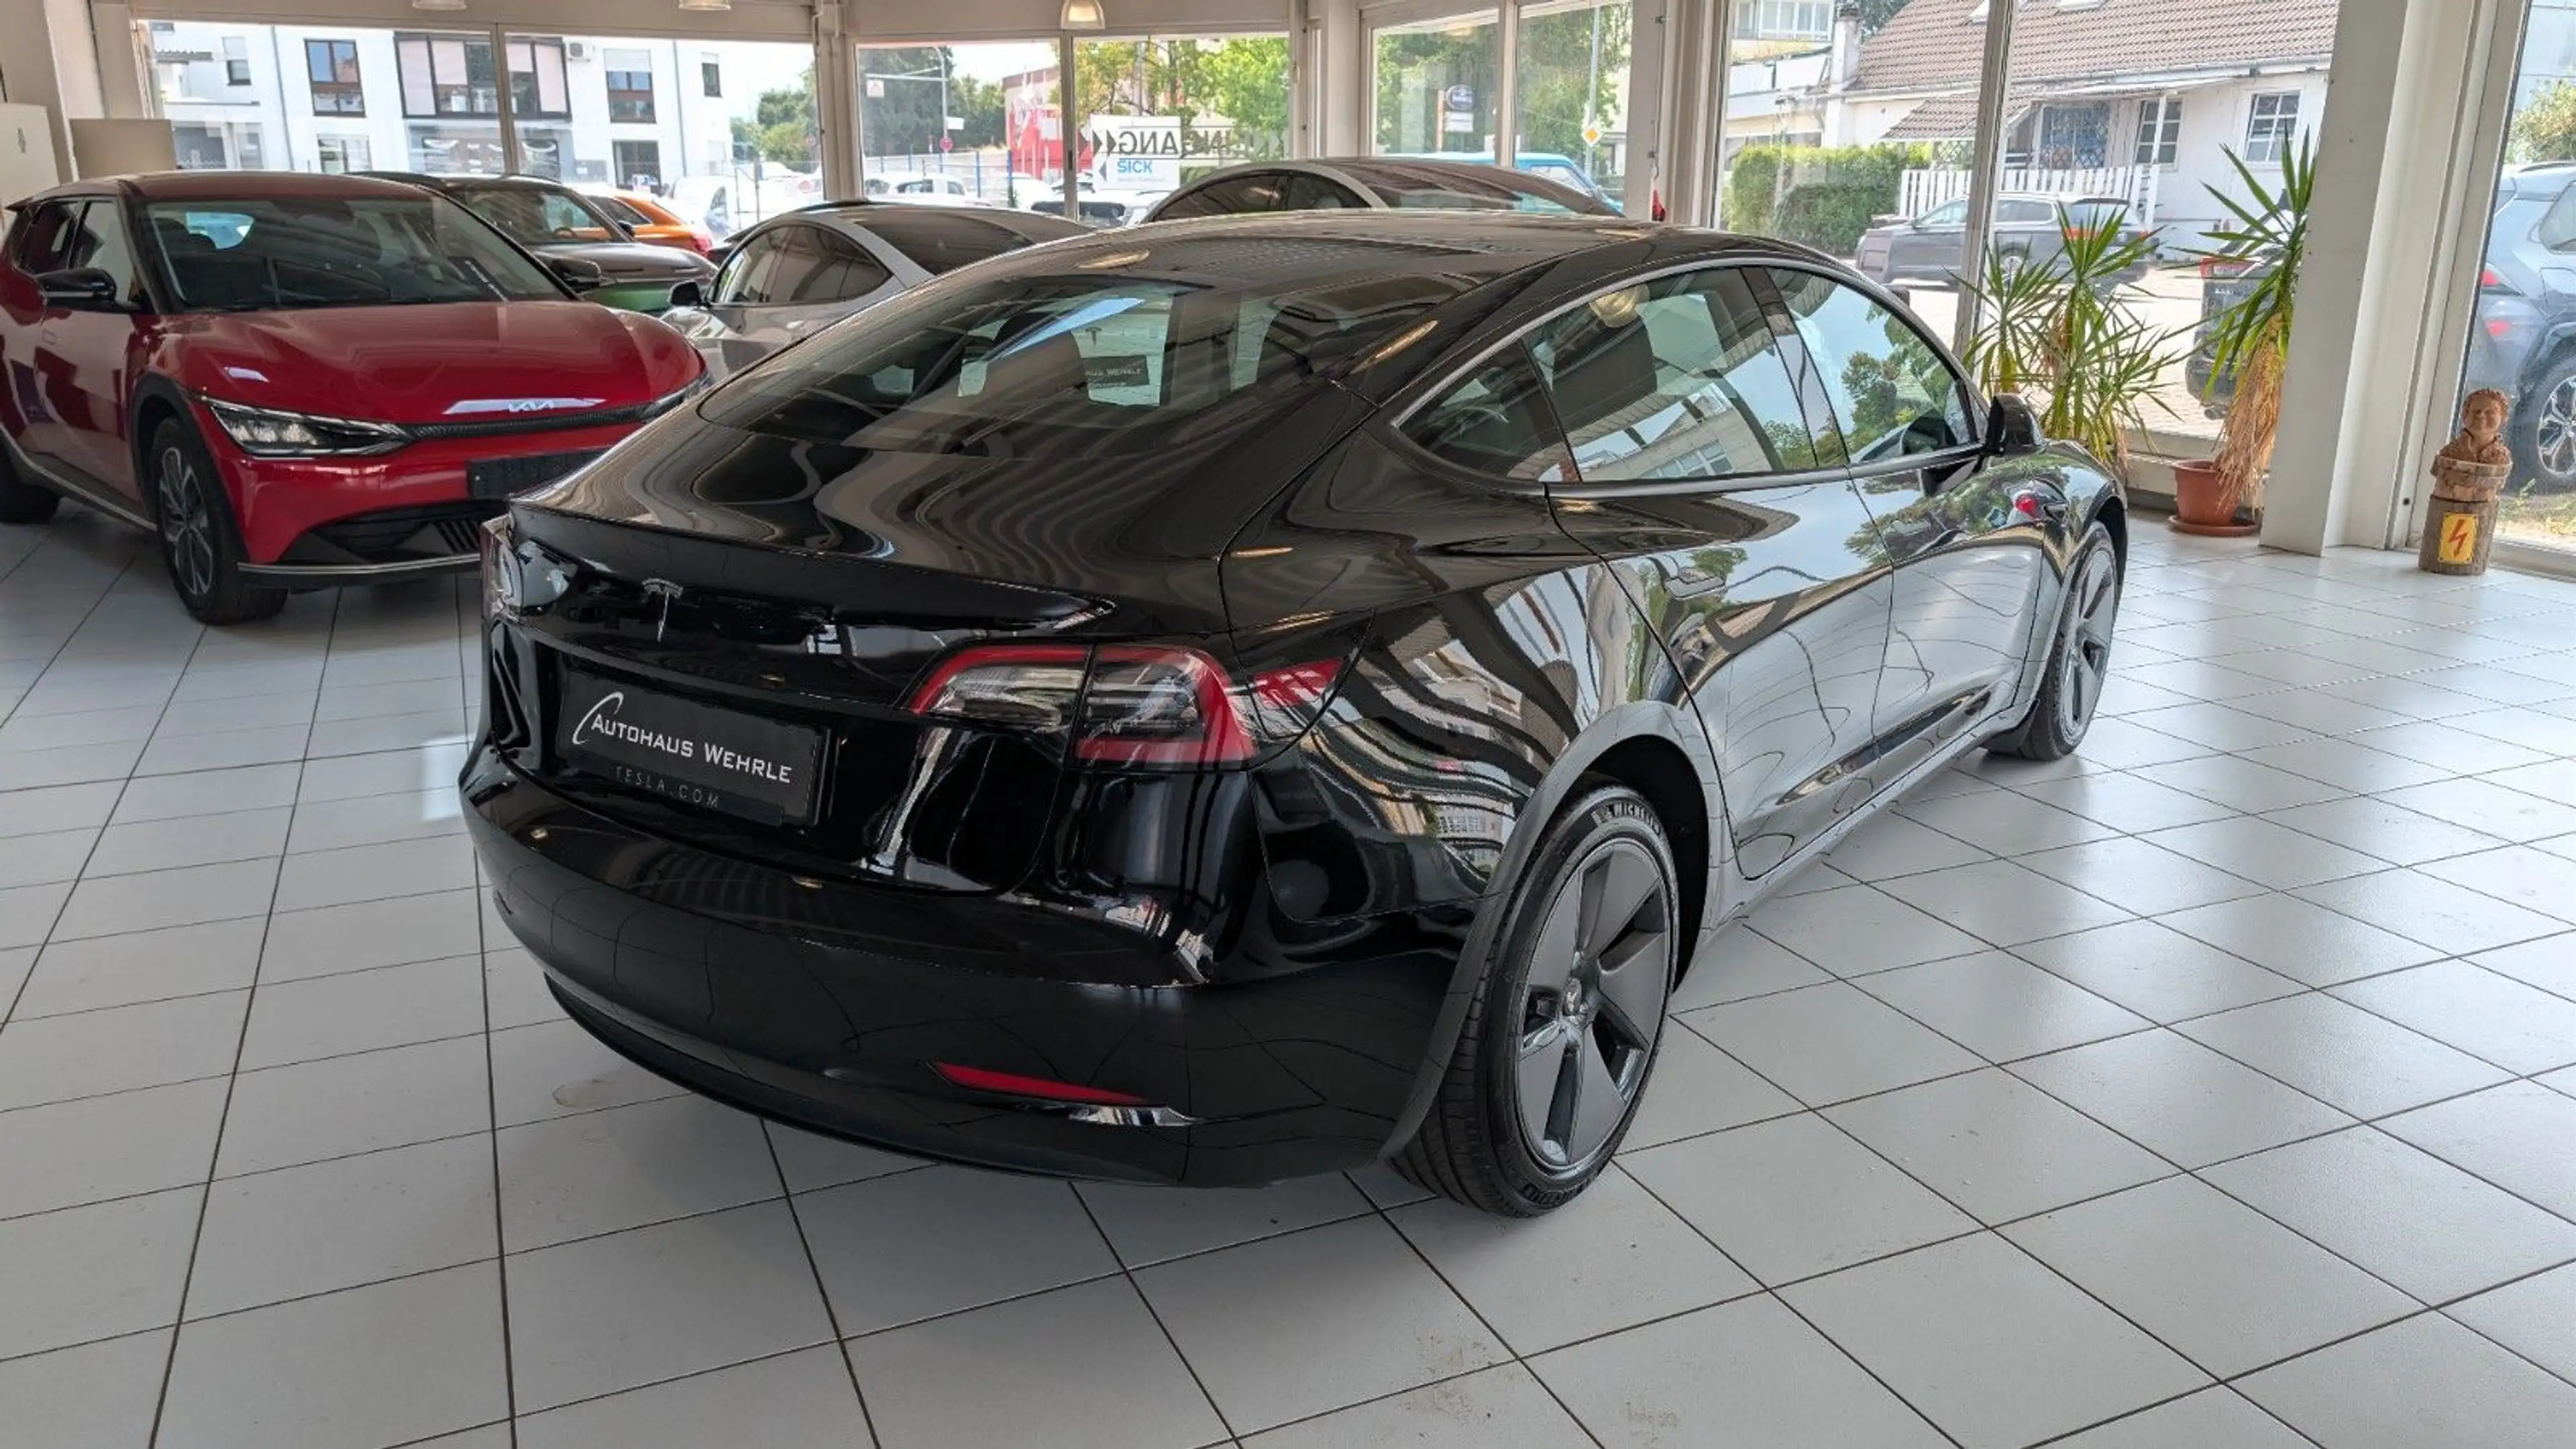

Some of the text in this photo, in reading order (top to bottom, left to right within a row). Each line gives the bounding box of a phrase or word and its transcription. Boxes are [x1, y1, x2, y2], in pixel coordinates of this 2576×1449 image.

[1116, 160, 1153, 174] SICK
[591, 714, 792, 784] AUTOHAUS WEHRLE
[616, 766, 720, 809] TESLA.COM
